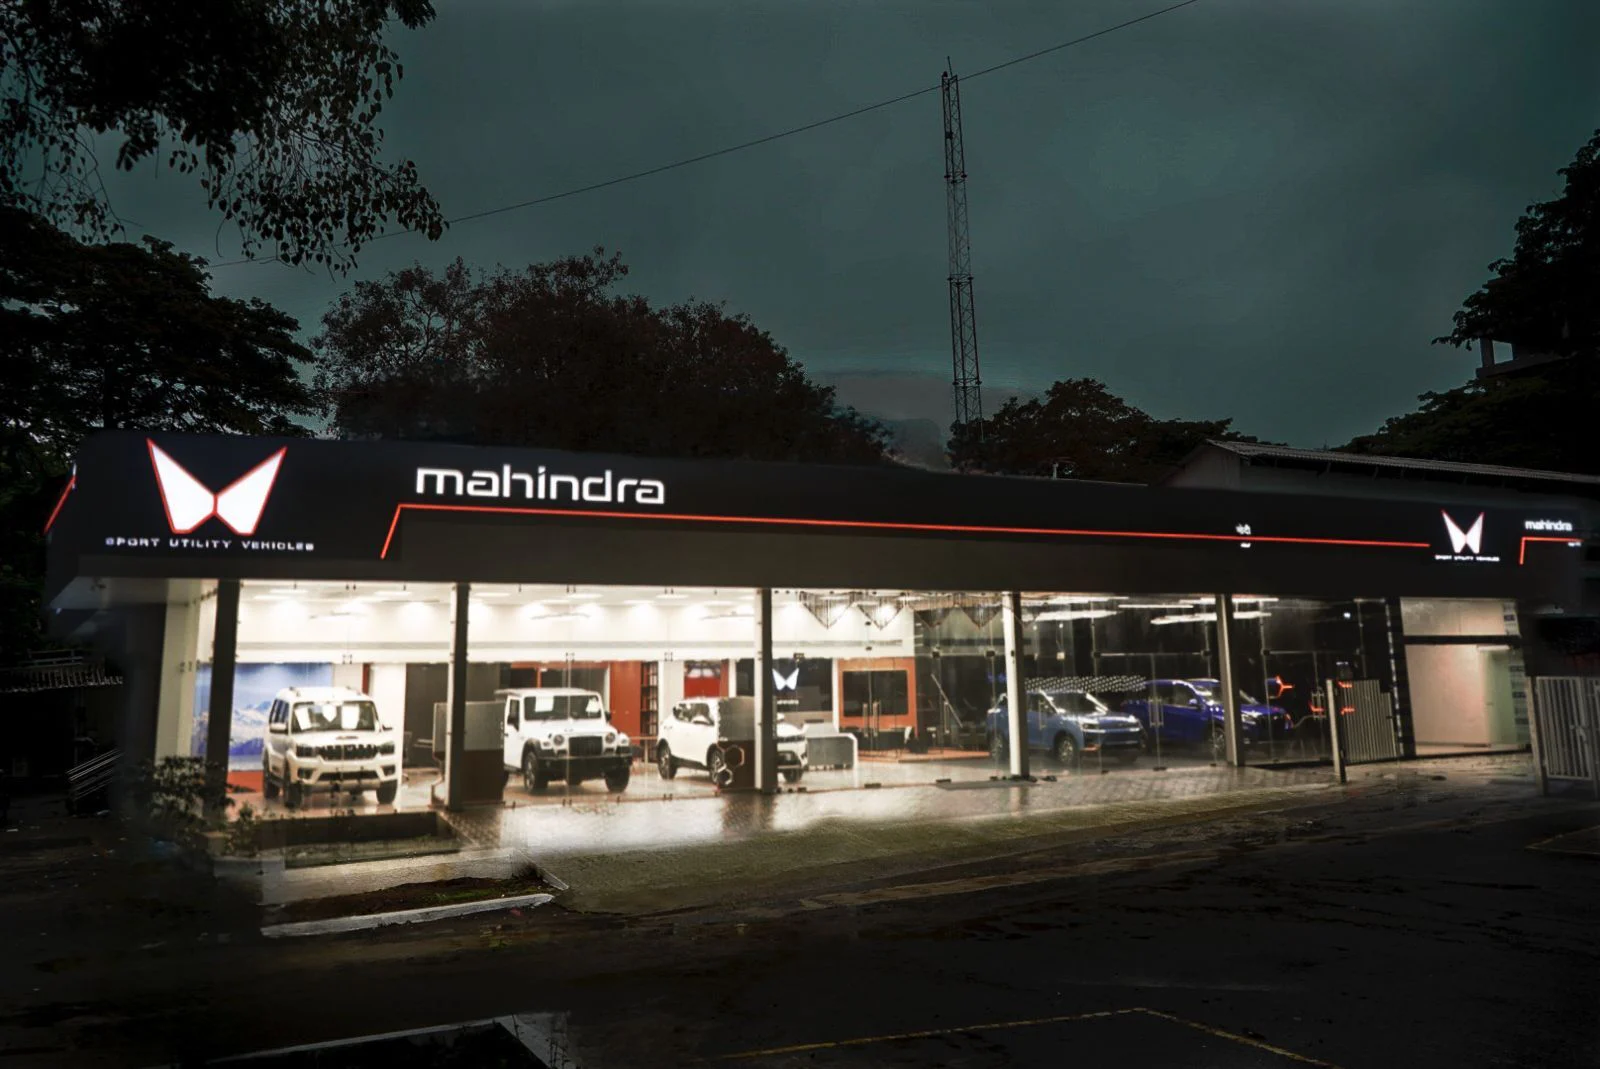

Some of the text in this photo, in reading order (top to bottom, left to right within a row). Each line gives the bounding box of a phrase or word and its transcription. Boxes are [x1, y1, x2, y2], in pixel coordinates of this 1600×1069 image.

[415, 463, 665, 505] mahindra
[1524, 519, 1573, 531] mahindra
[105, 537, 315, 551] SPORT UTILITY VEHICLES
